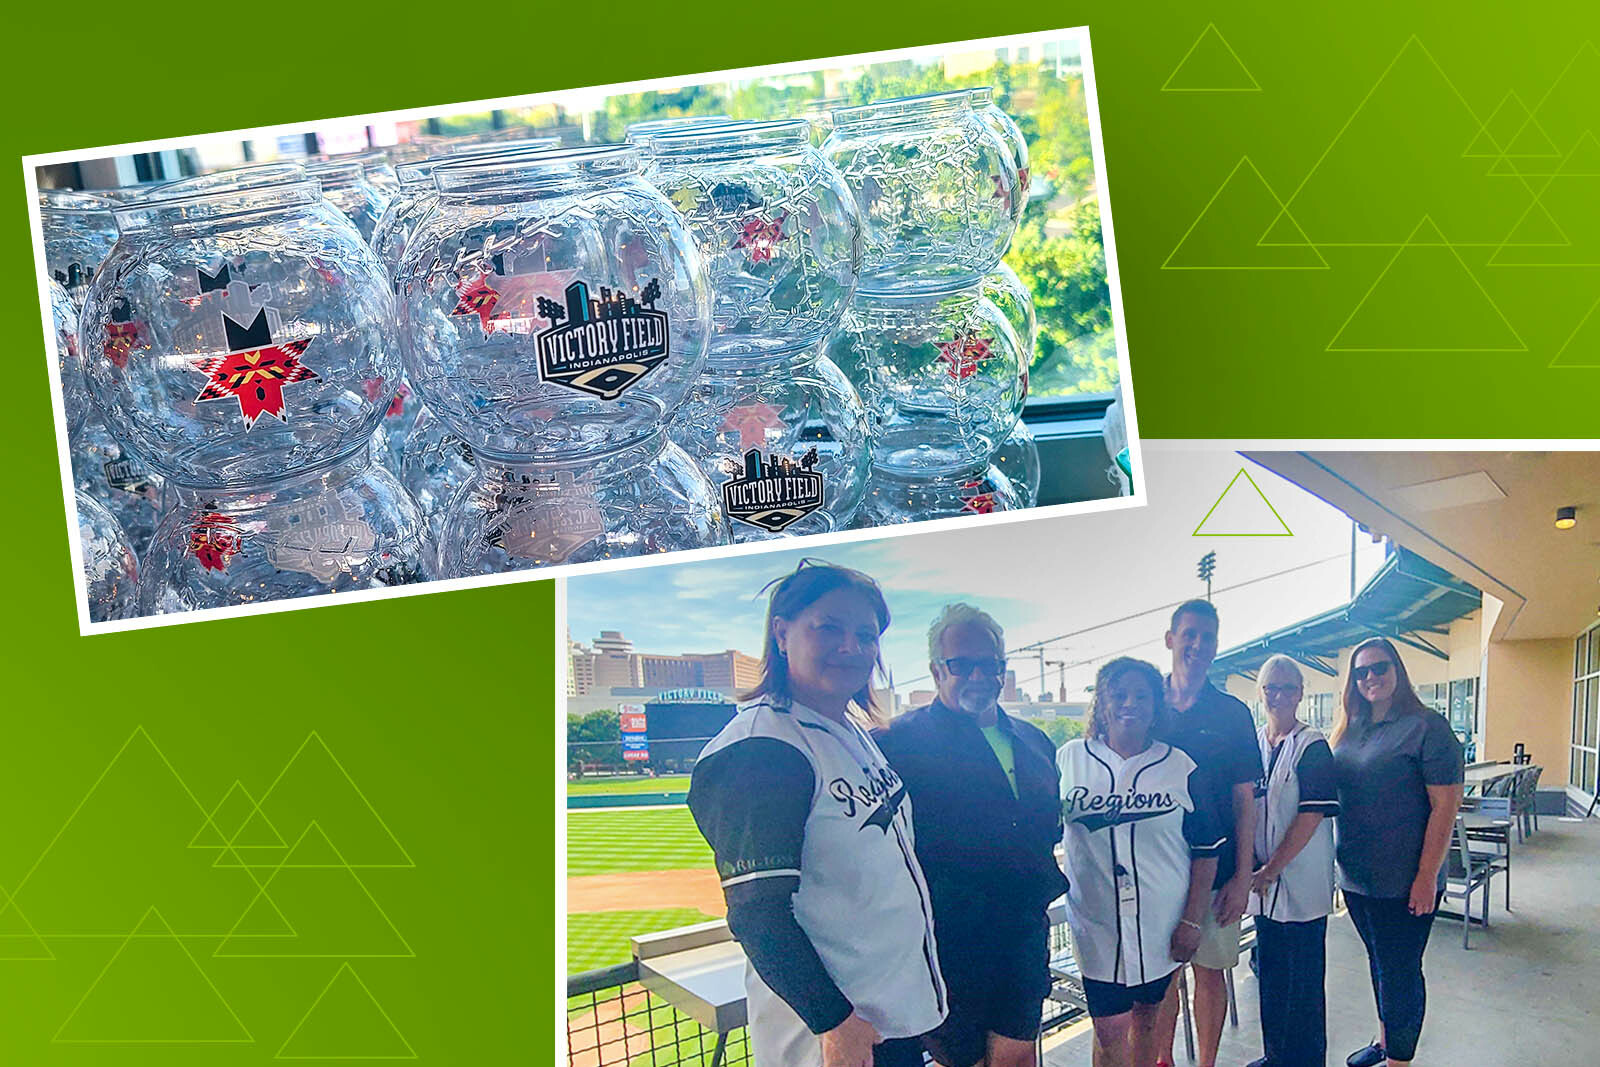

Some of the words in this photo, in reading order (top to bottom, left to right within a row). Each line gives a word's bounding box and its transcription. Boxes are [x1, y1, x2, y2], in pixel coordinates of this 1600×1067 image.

[547, 320, 619, 365] VICTORY
[621, 317, 663, 351] FIELD
[569, 350, 649, 369] INDIANAPOLIS
[729, 478, 782, 506] VICTORY
[785, 476, 818, 500] FIELD
[744, 500, 806, 510] INDIANAPOLIS
[1065, 786, 1173, 821] Regions
